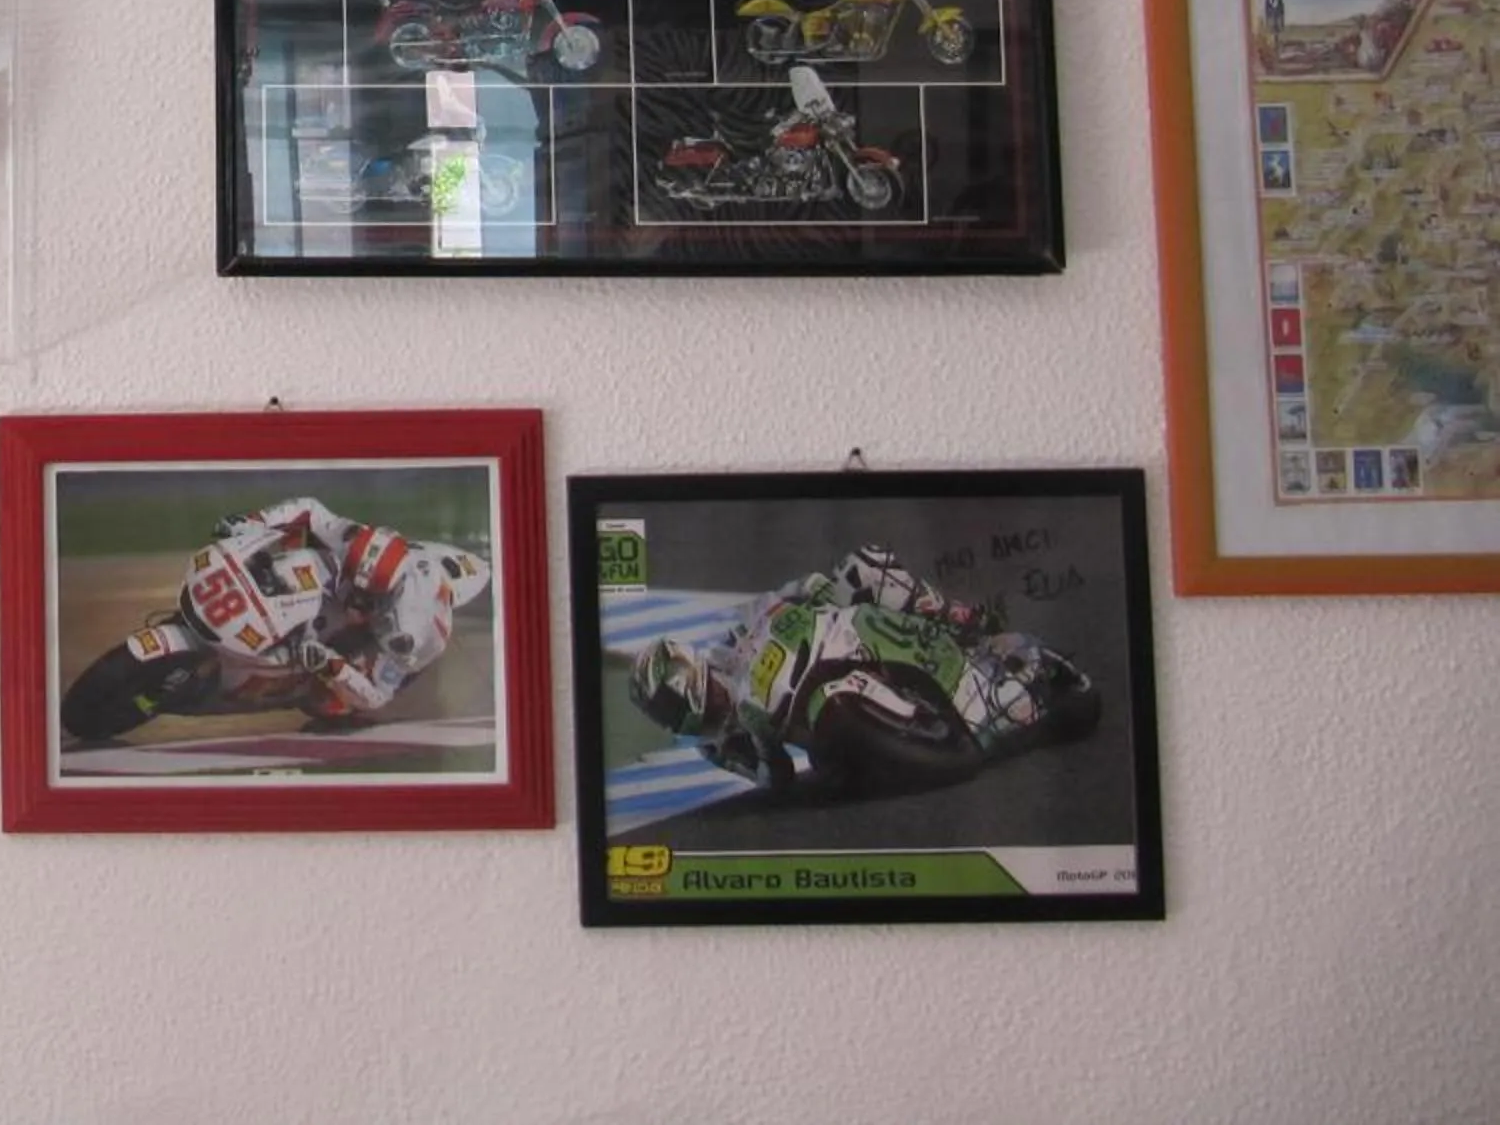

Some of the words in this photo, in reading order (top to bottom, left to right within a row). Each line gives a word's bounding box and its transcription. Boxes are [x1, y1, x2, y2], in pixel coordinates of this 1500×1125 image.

[598, 536, 639, 562] GO
[192, 567, 249, 628] 58
[605, 845, 673, 877] 19
[683, 868, 782, 891] Alvaro
[796, 867, 916, 890] Bautista
